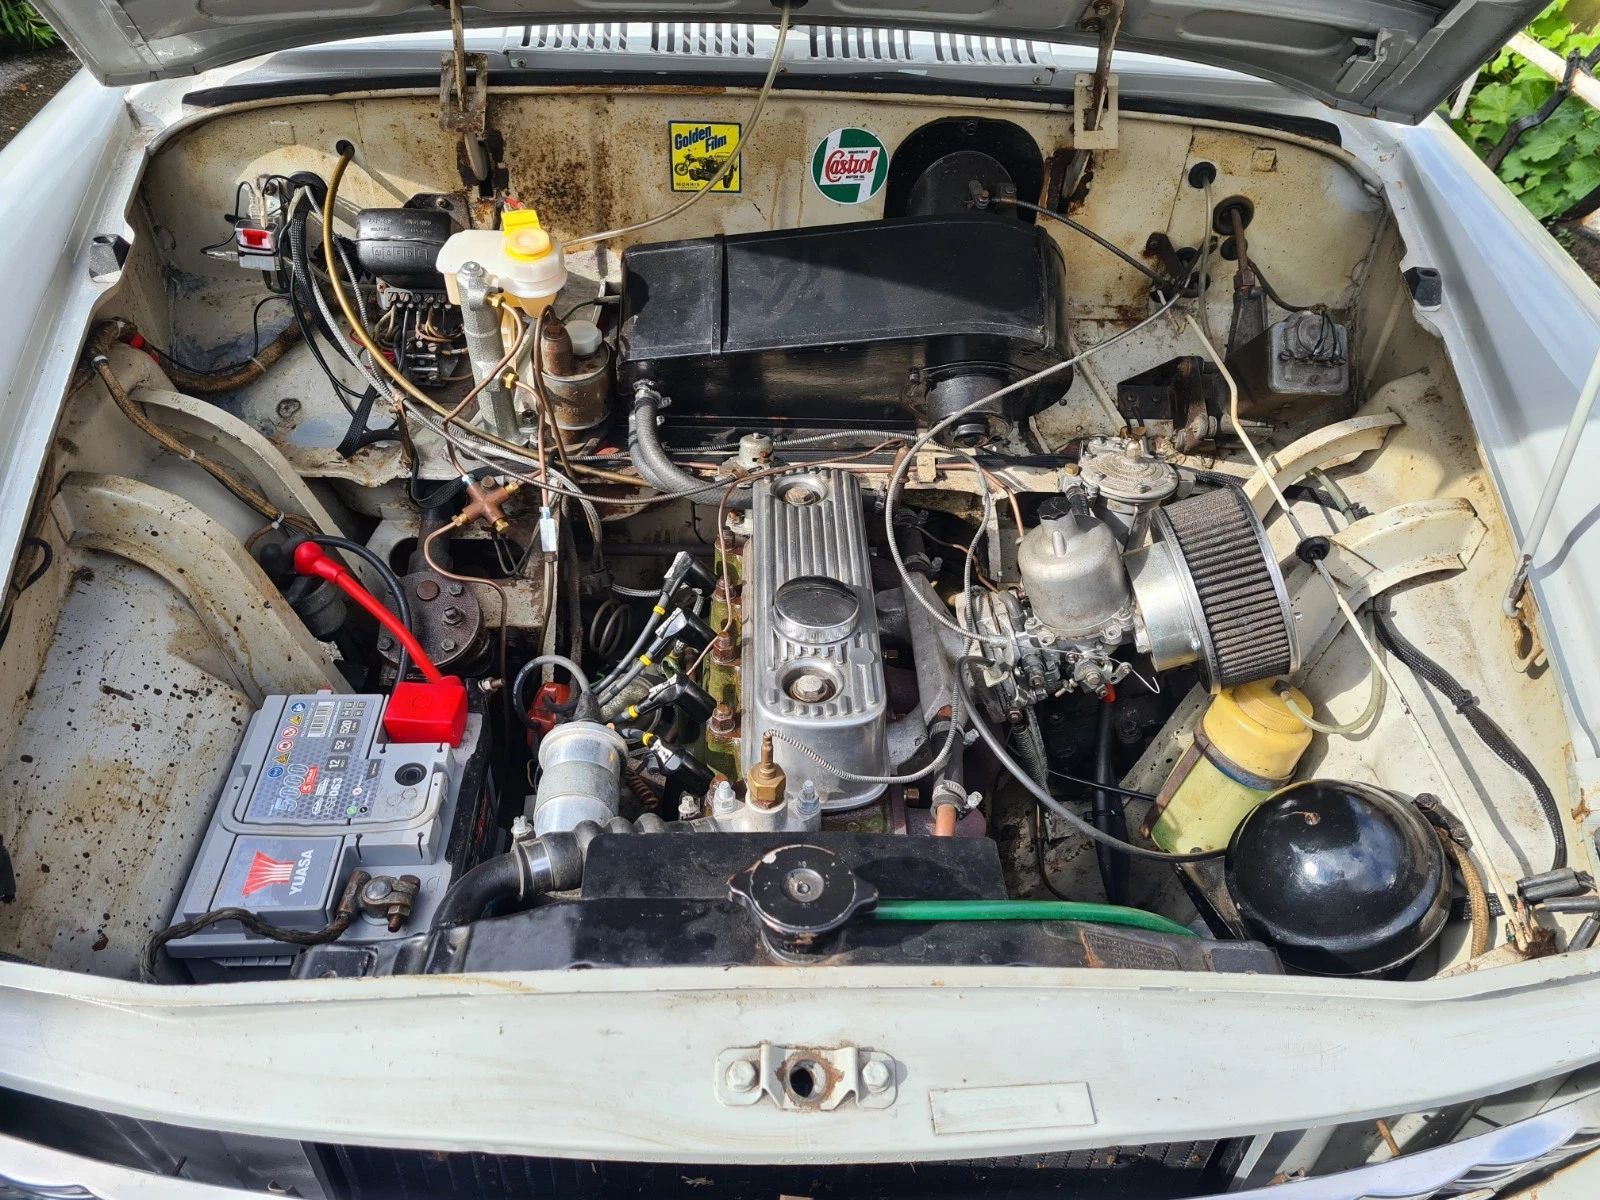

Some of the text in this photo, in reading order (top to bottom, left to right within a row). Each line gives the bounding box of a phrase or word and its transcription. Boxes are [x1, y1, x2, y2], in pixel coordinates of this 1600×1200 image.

[675, 126, 712, 150] Golden
[705, 135, 727, 153] Film
[825, 150, 877, 182] Castrol
[340, 720, 352, 734] 520
[334, 740, 346, 750] 52
[329, 759, 341, 769] 12
[274, 763, 309, 812] 5000
[324, 777, 343, 815] HSB063
[289, 849, 315, 896] YUASA
